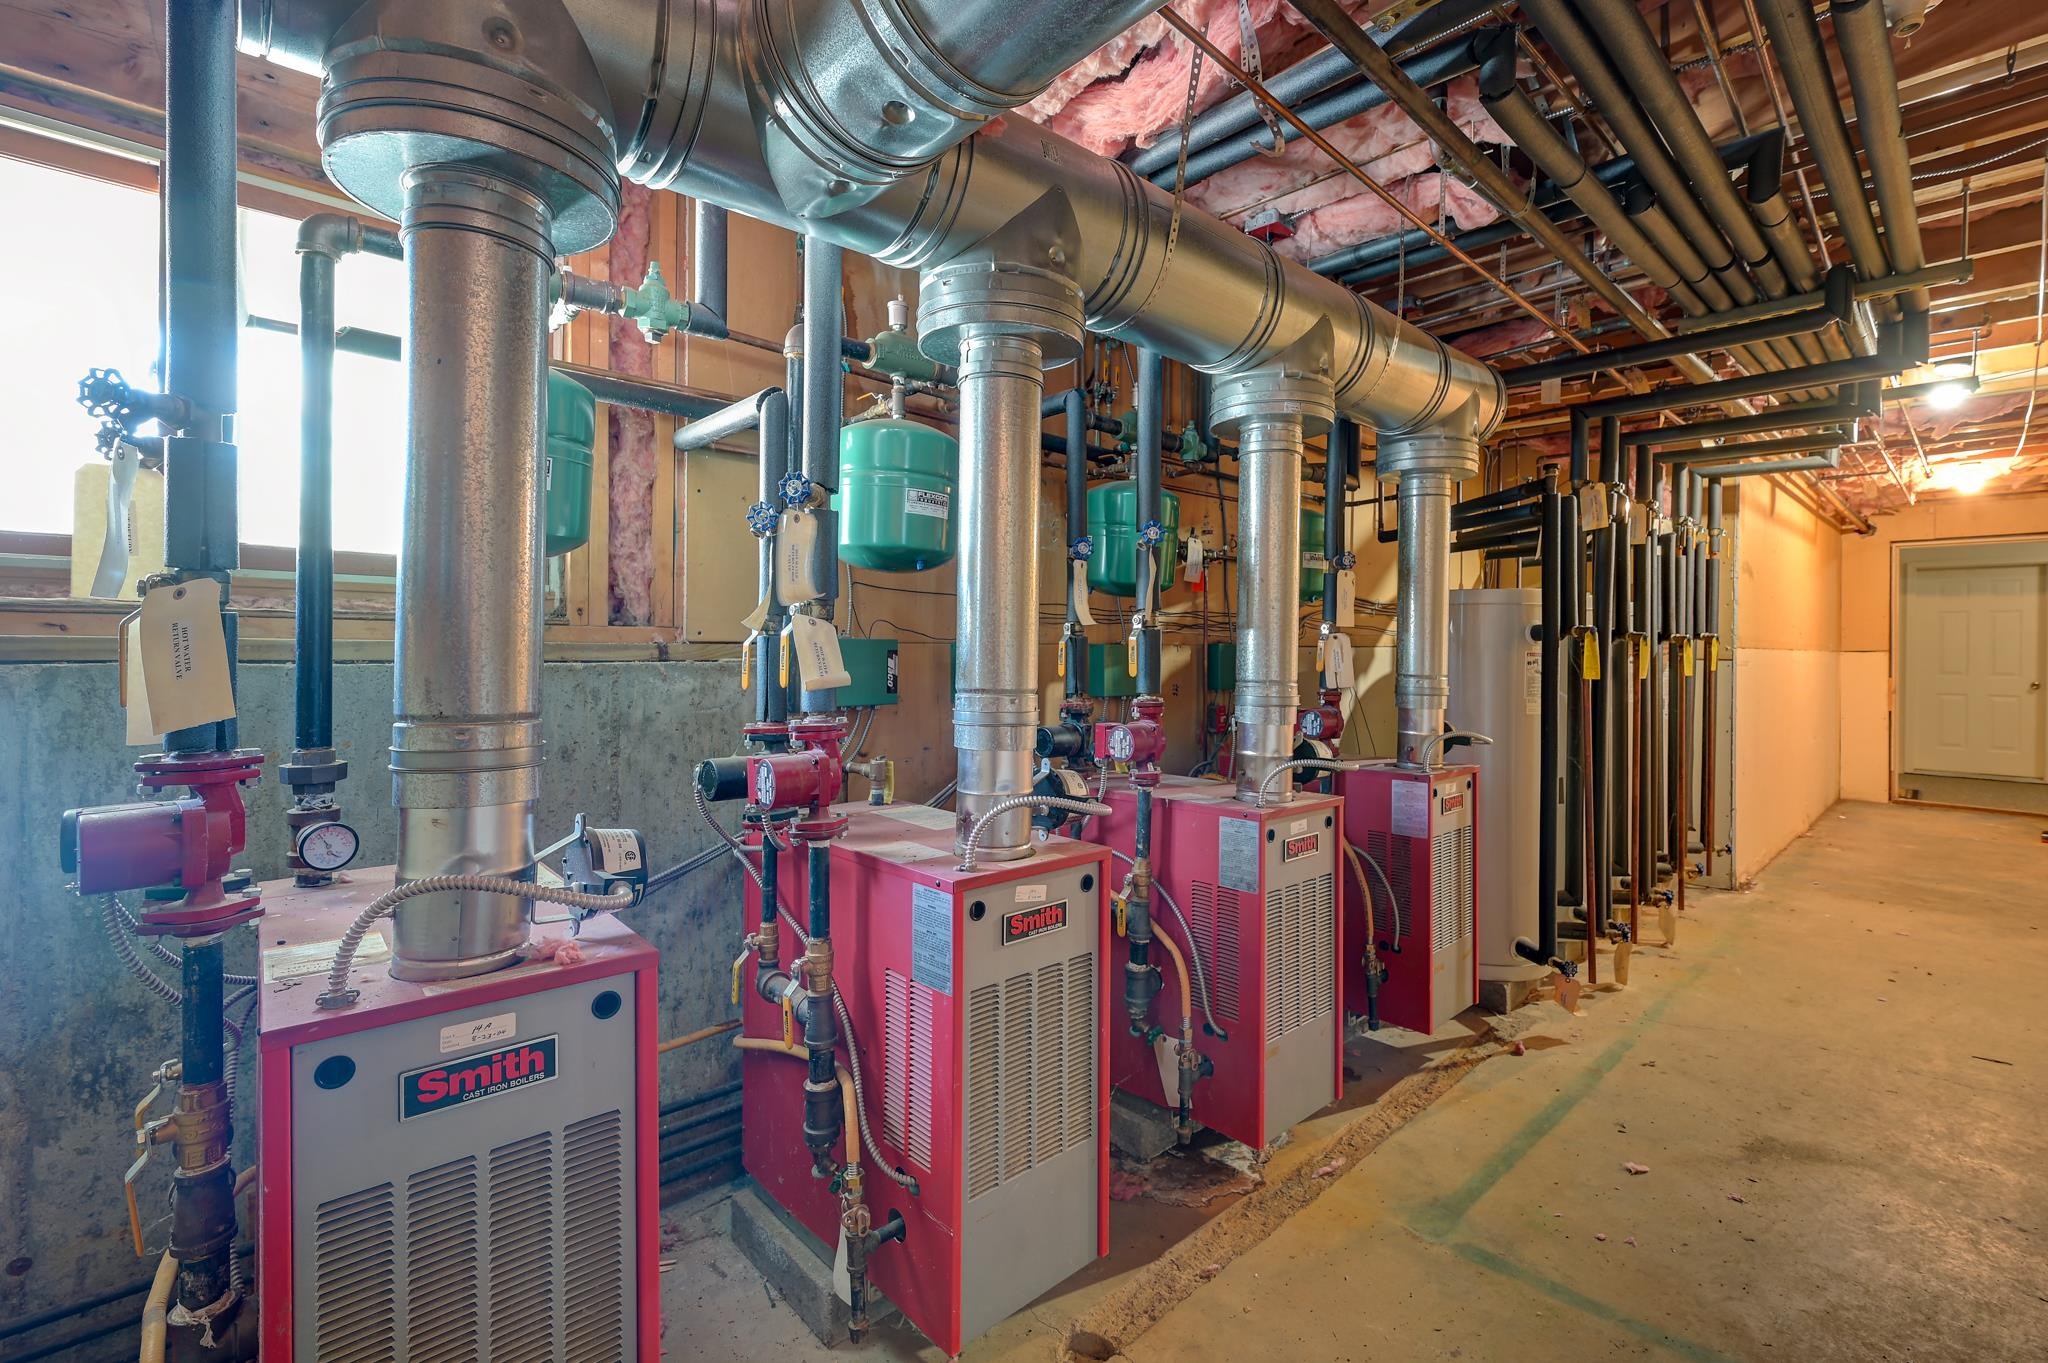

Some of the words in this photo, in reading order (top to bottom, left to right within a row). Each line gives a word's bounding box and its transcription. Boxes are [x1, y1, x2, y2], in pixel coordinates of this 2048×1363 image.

[172, 622, 180, 654] RETURN
[183, 644, 191, 672] WATER
[1446, 796, 1463, 810] Smith
[1288, 836, 1316, 854] Smith
[1011, 905, 1063, 935] Smith
[417, 1047, 545, 1103] Smith
[462, 1088, 485, 1101] CAST
[487, 1082, 508, 1094] IRON
[510, 1072, 545, 1087] BOILERS
